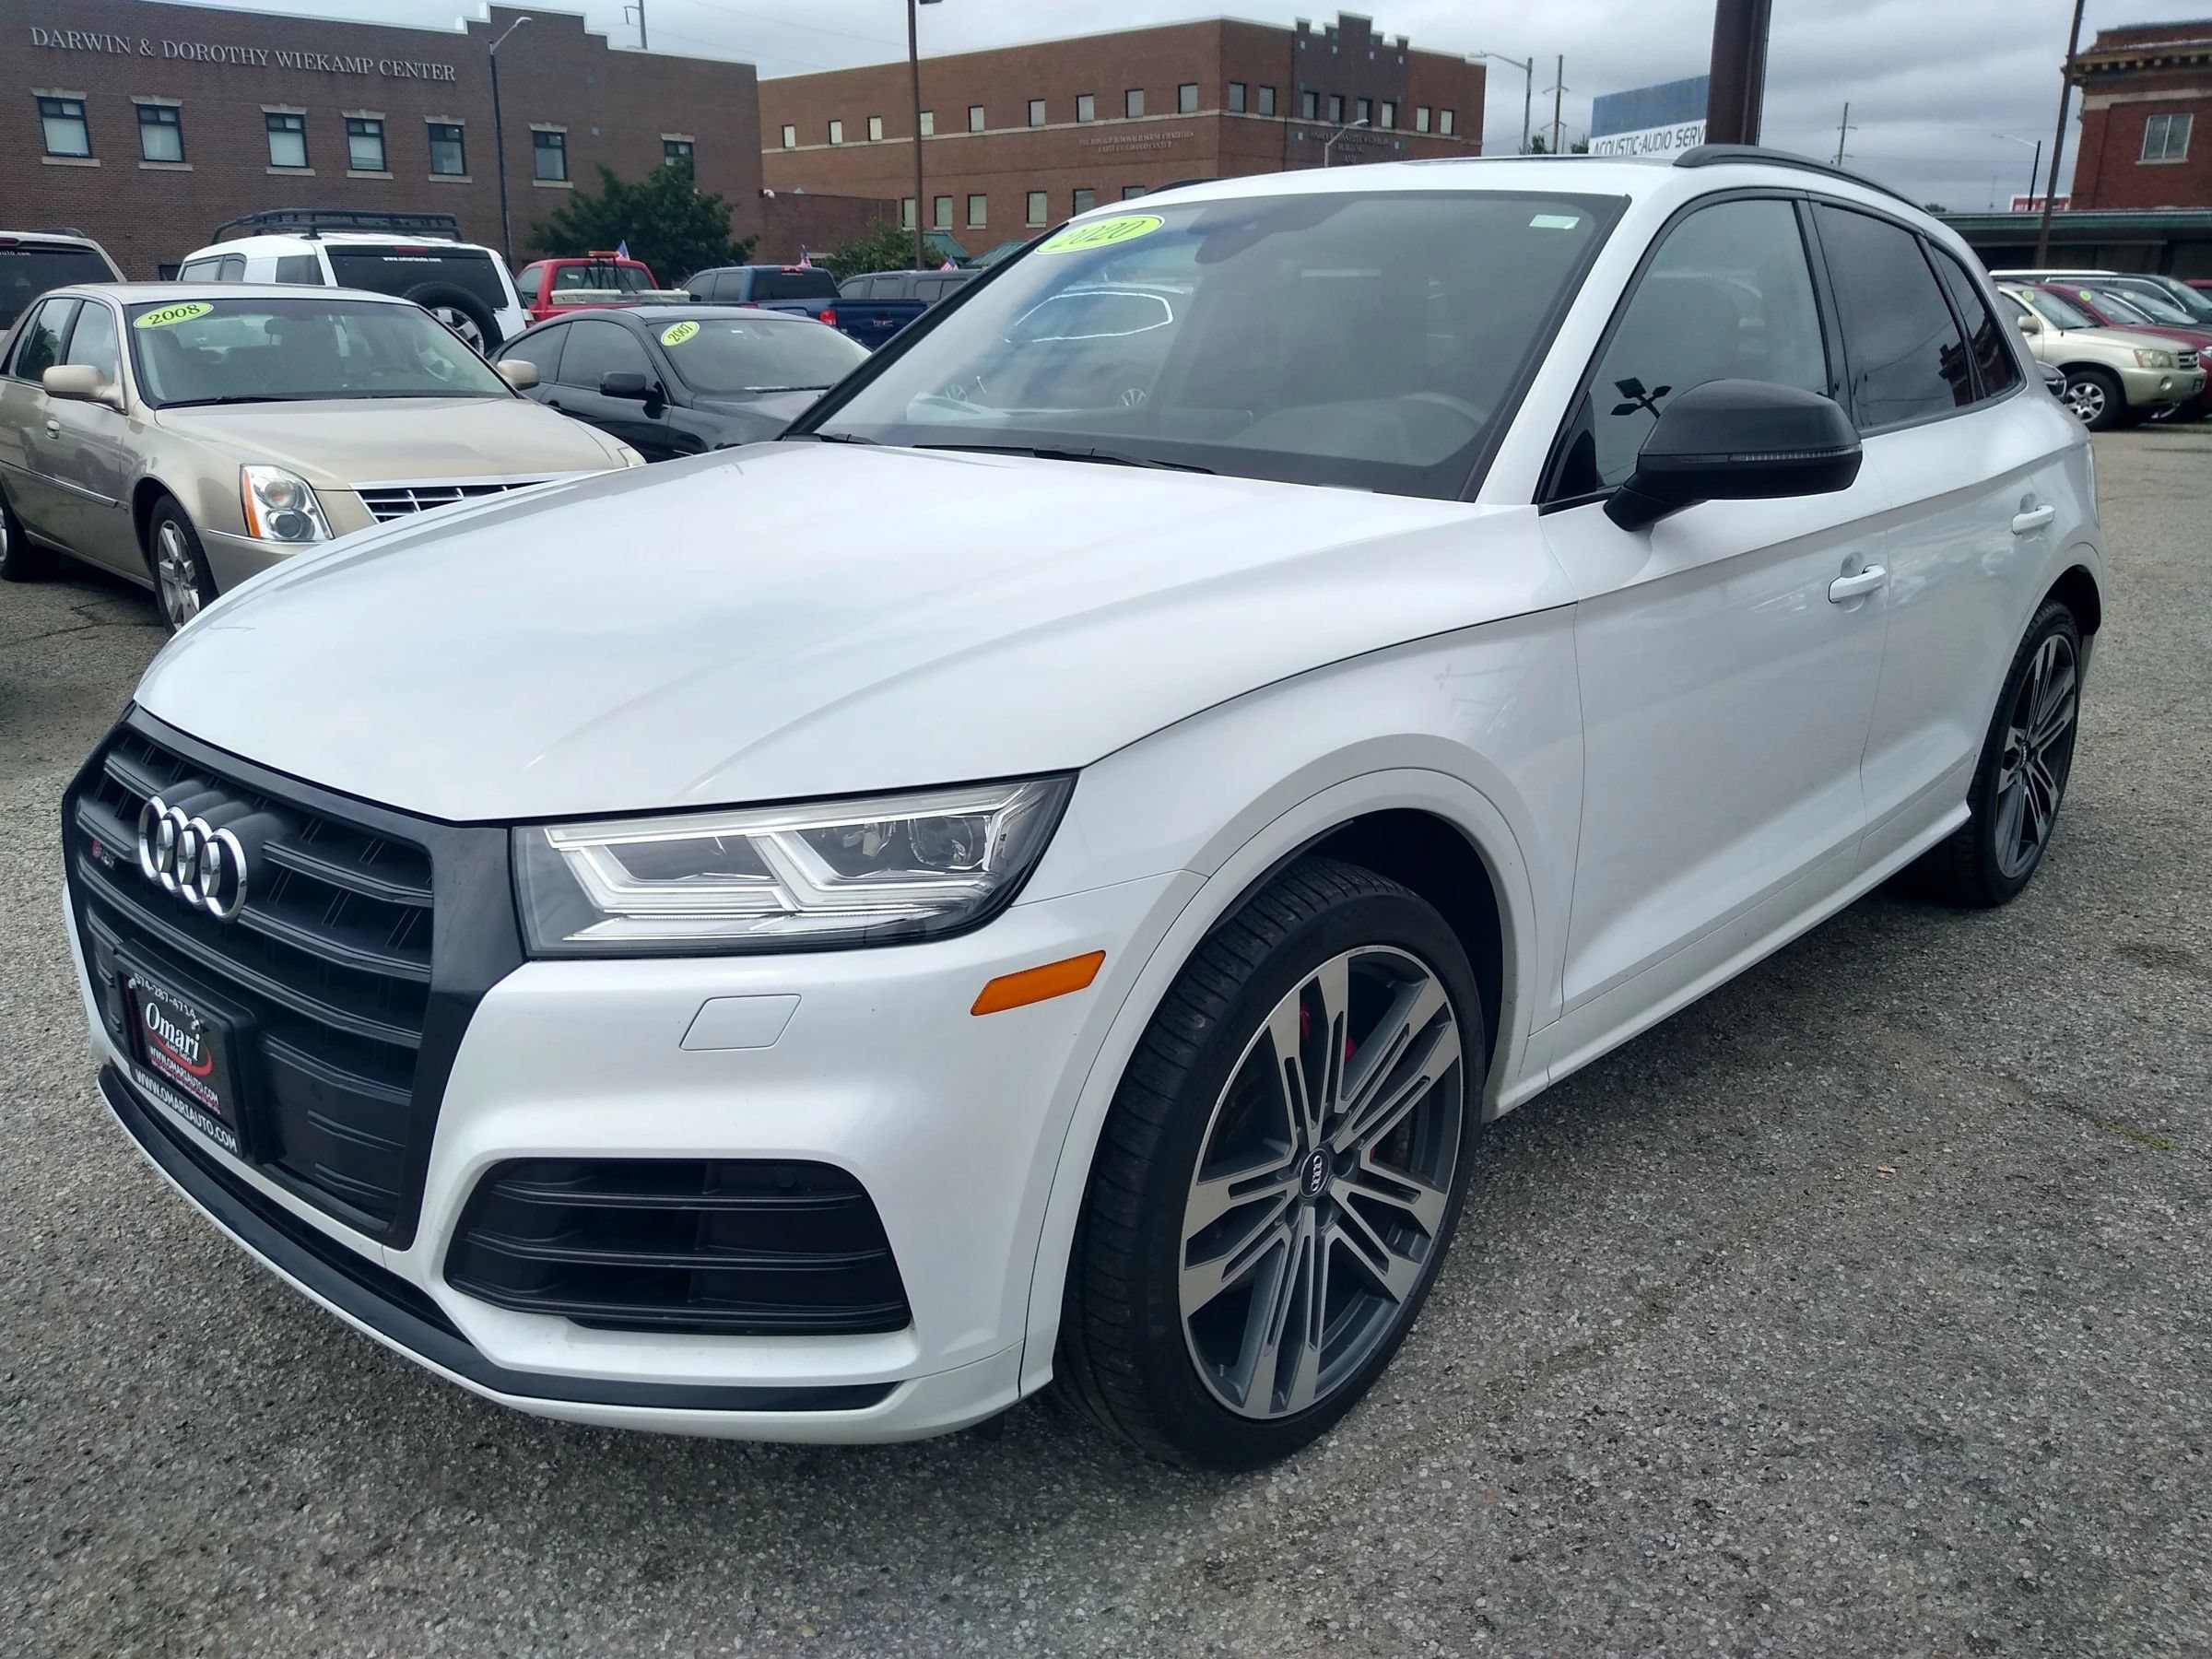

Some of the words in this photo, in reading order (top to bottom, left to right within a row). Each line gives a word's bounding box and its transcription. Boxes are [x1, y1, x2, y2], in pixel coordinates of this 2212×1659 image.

[29, 27, 133, 55] DARWIN
[139, 38, 156, 57] &
[161, 40, 269, 66] DOROTHY
[275, 50, 373, 75] WIEKAMP
[379, 59, 456, 81] CENTER
[1048, 220, 1147, 250] 2020
[148, 304, 201, 325] 2008
[667, 324, 693, 342] 2007
[146, 1002, 200, 1061] Omari
[148, 1044, 219, 1106] WWW.OMARIAUTO.COM
[135, 1068, 238, 1153] WWW.OMARIAUTO.COM
